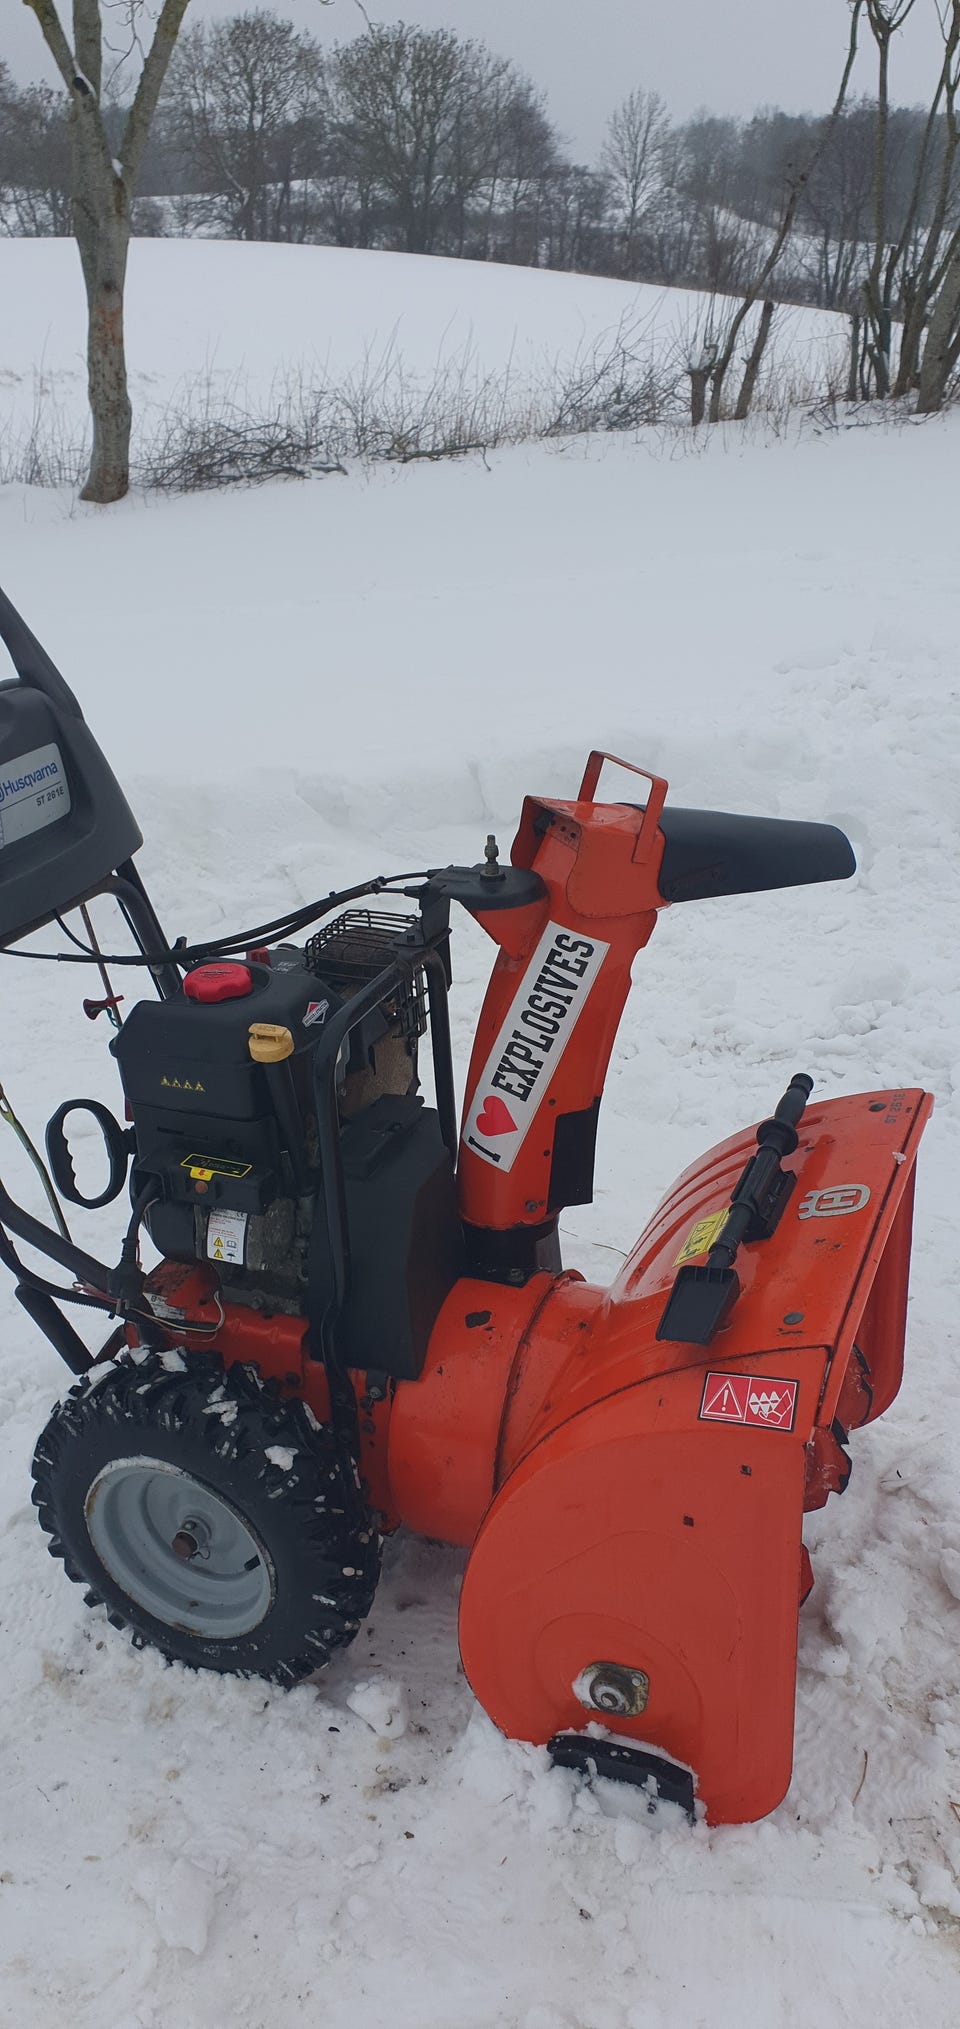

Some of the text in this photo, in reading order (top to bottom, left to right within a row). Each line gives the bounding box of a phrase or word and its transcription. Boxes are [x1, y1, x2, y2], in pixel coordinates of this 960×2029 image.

[3, 762, 58, 796] Husqvarna
[36, 795, 45, 806] ST
[467, 933, 595, 1163] I EXPLOSIVES
